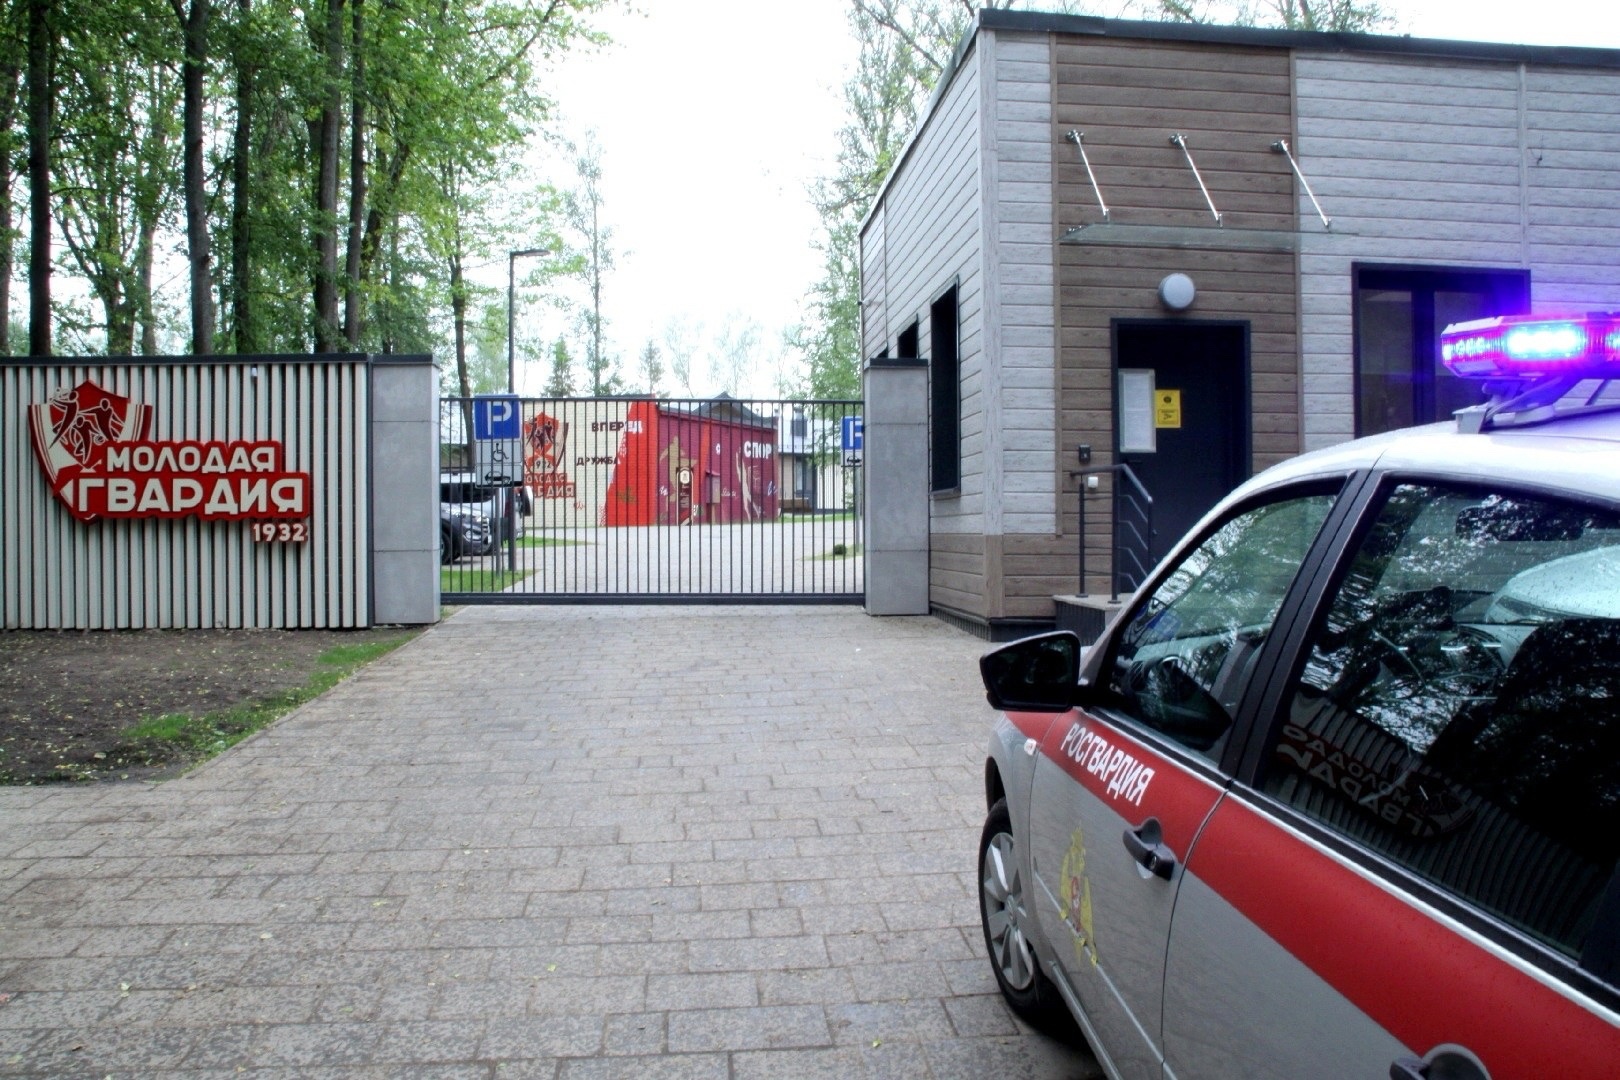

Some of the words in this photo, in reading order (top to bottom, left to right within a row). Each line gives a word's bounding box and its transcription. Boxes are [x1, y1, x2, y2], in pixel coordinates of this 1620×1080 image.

[486, 399, 512, 436] P
[106, 446, 275, 474] МОЛОДАЯ
[78, 477, 303, 515] ГВАРДИЯ
[253, 523, 305, 542] 1932
[1060, 722, 1156, 807] РОСГВАРДИЯ
